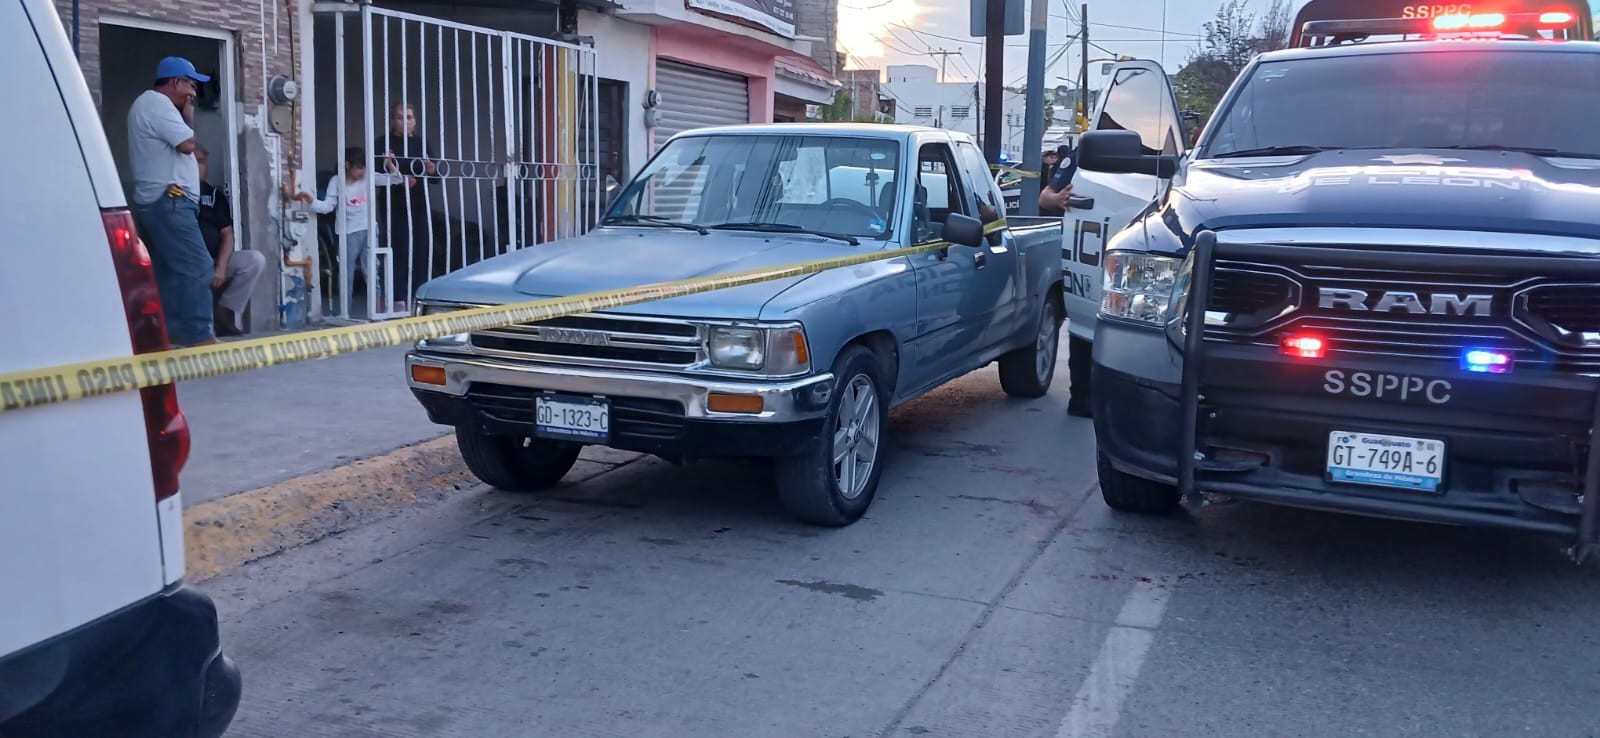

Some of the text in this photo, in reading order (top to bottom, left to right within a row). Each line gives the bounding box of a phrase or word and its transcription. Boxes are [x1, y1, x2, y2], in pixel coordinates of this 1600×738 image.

[1318, 287, 1493, 316] RAM
[540, 327, 609, 346] TOYOTA
[1324, 370, 1451, 404] SSPPC
[537, 405, 608, 430] GD-1323-C
[1333, 445, 1437, 474] GT-749A-6
